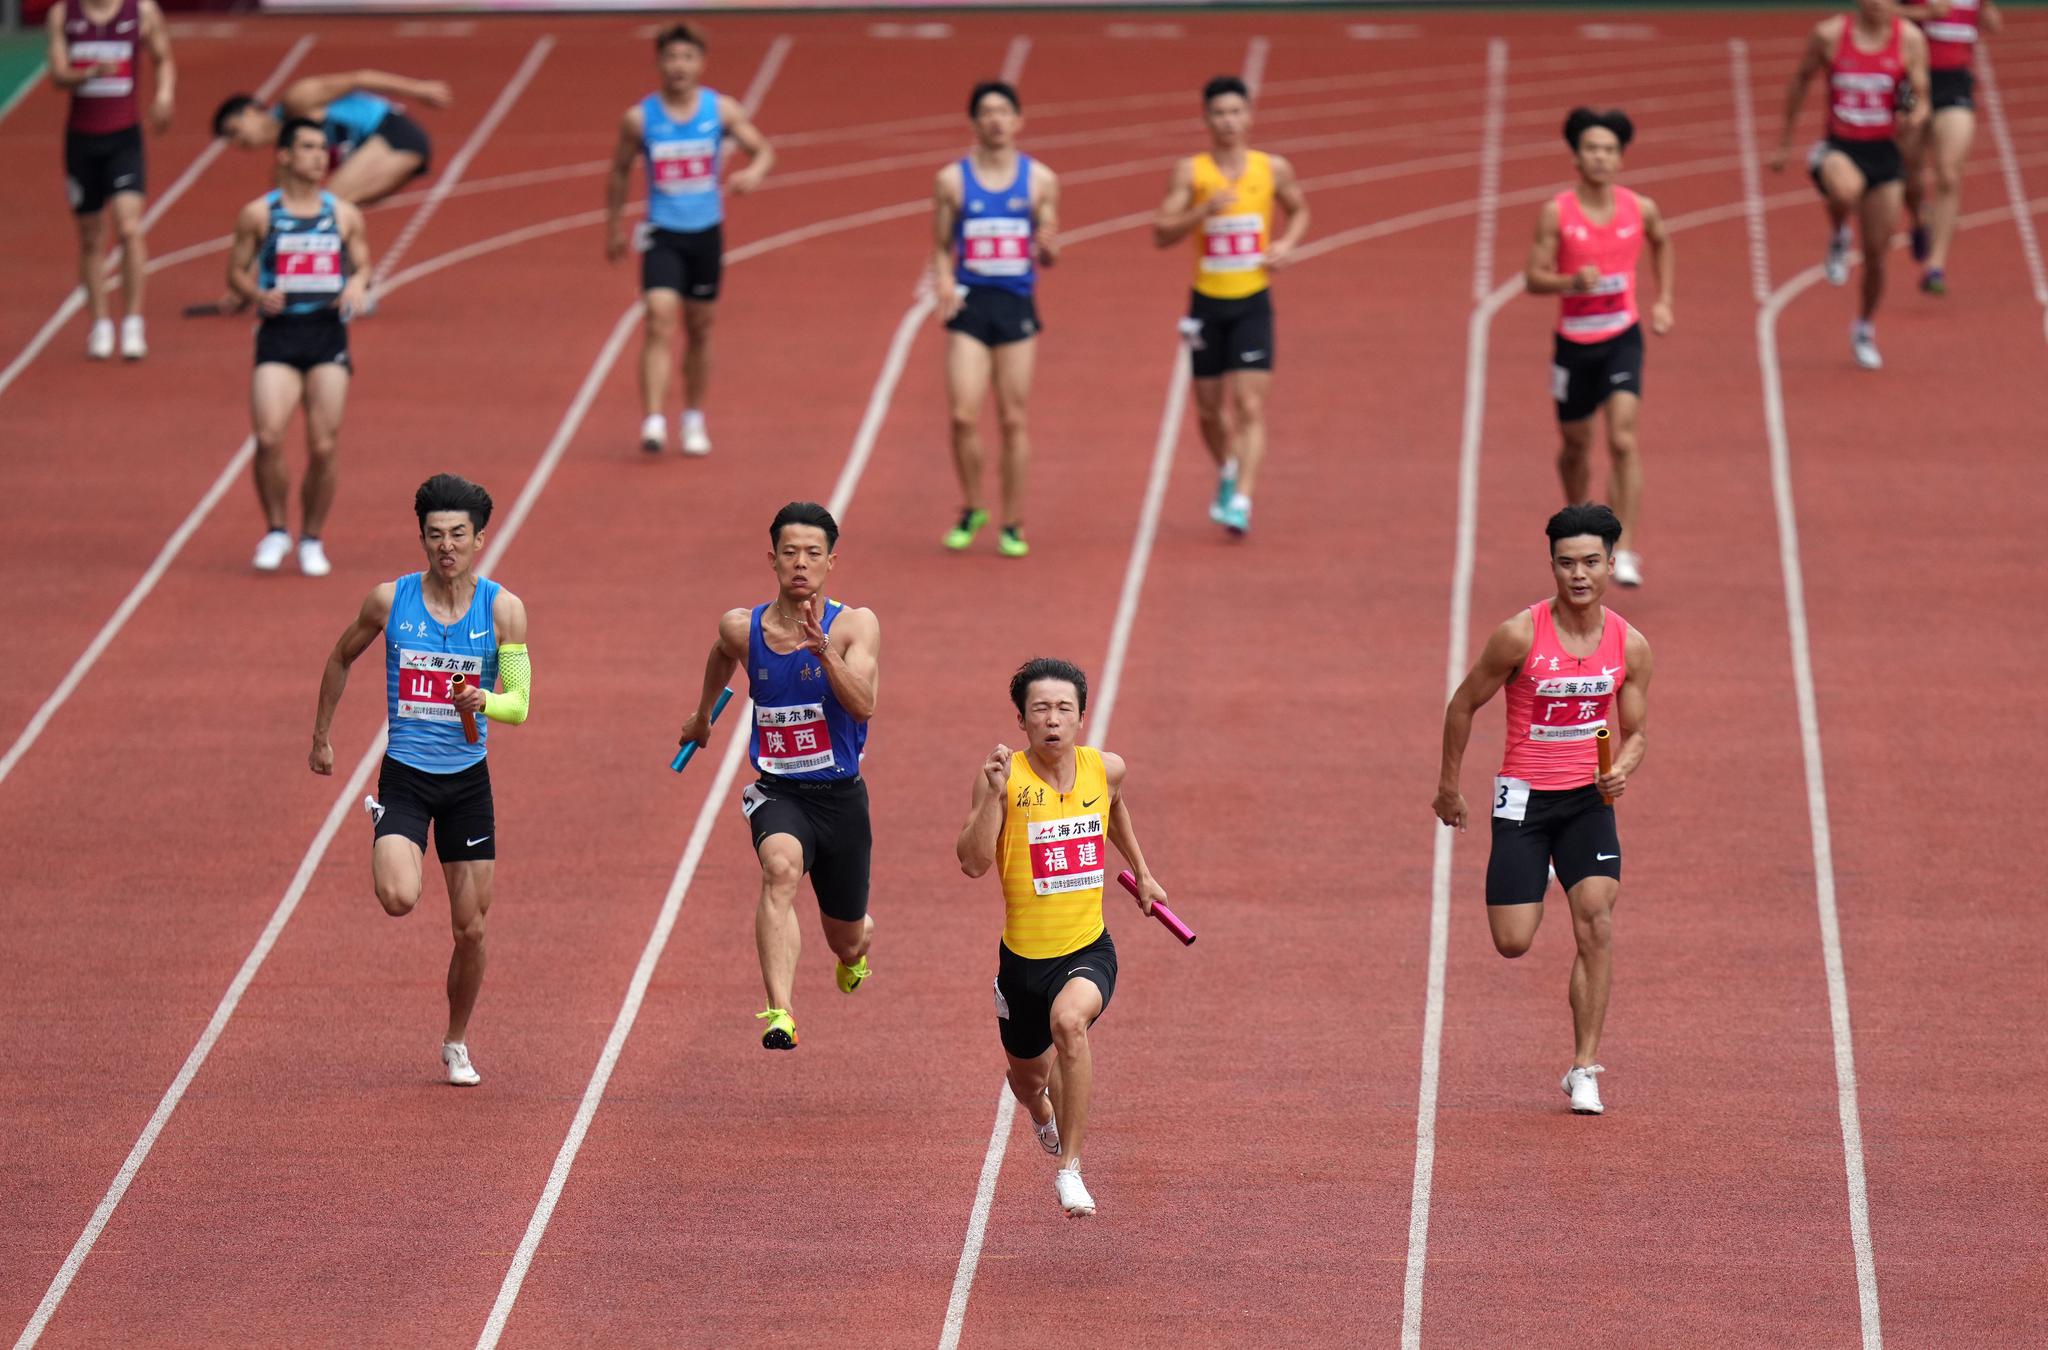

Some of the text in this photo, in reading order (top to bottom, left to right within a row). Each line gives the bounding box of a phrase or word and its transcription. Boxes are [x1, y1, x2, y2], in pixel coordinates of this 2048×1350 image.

[431, 656, 477, 671] 海尔斯
[1565, 681, 1608, 694] 海尔斯
[775, 709, 817, 724] 海尔斯
[1544, 701, 1599, 721] 广东
[766, 728, 818, 753] 陕西
[1496, 785, 1509, 808] 3
[1058, 820, 1101, 837] 海尔斯
[1044, 842, 1098, 872] 福建
